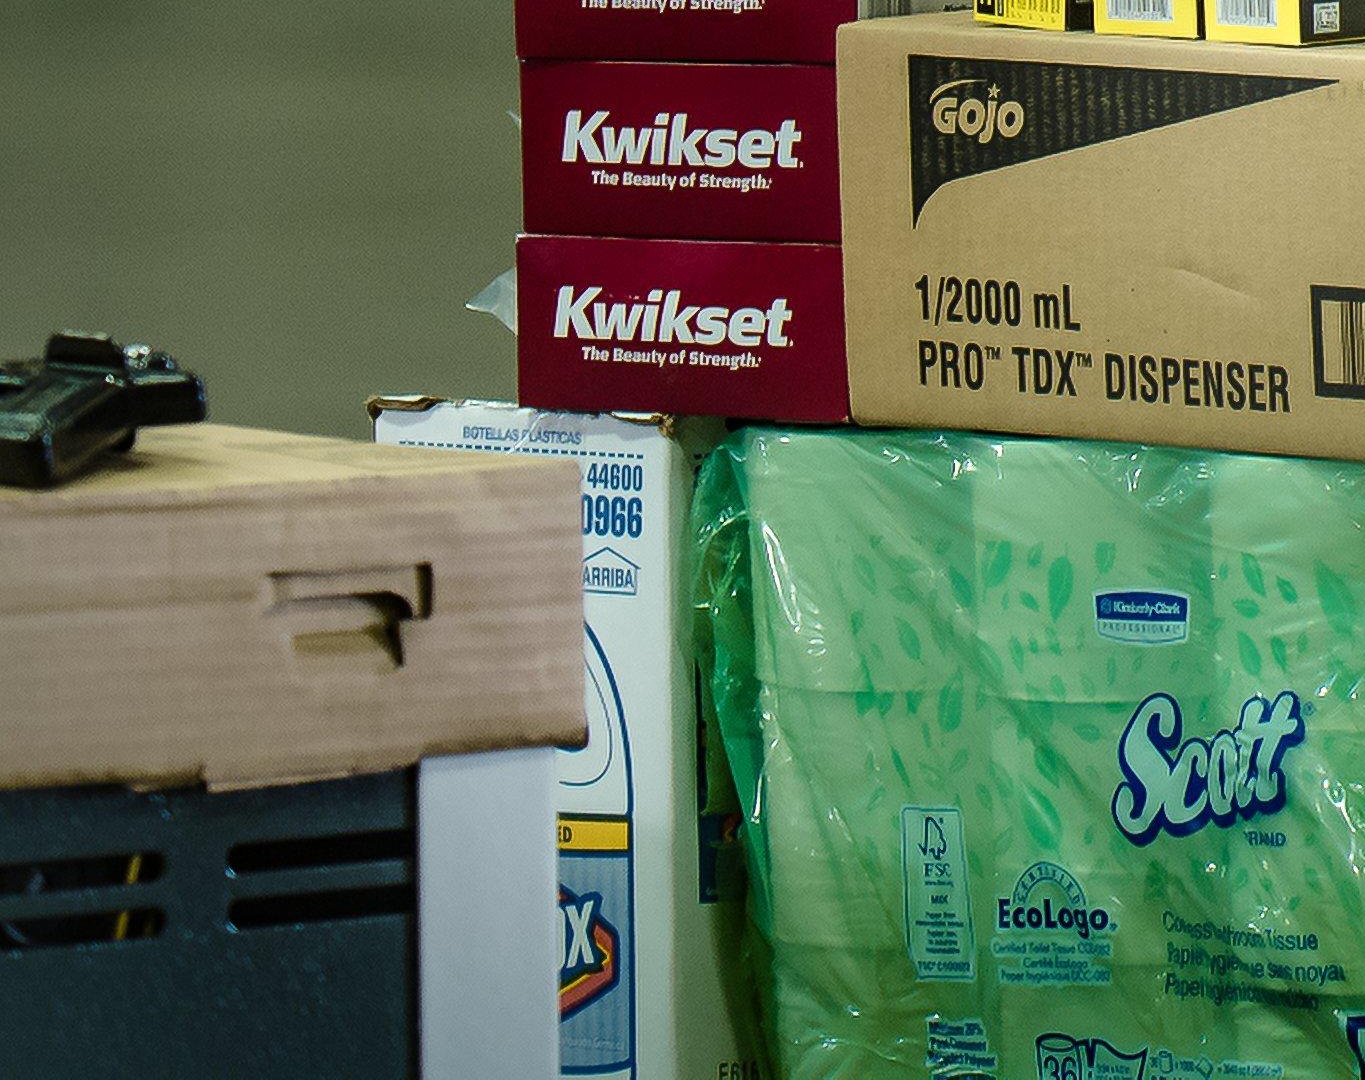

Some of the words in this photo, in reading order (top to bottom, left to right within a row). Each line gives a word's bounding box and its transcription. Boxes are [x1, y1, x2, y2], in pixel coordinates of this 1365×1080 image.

[561, 109, 803, 169] Kwikset
[591, 170, 619, 186] The
[621, 171, 678, 190] Beauty
[680, 172, 697, 187] of
[552, 285, 793, 347] Kwikset
[914, 274, 1022, 327] 1/2000
[1033, 283, 1081, 332] mL
[581, 346, 611, 362] The
[613, 347, 668, 367] Beauty
[670, 350, 687, 365] of
[1104, 352, 1291, 413] DISPENSER
[587, 462, 643, 492] 44600
[583, 565, 635, 588] ARRIBA
[1112, 690, 1305, 848] Scott
[997, 898, 1110, 940] EcoLogo
